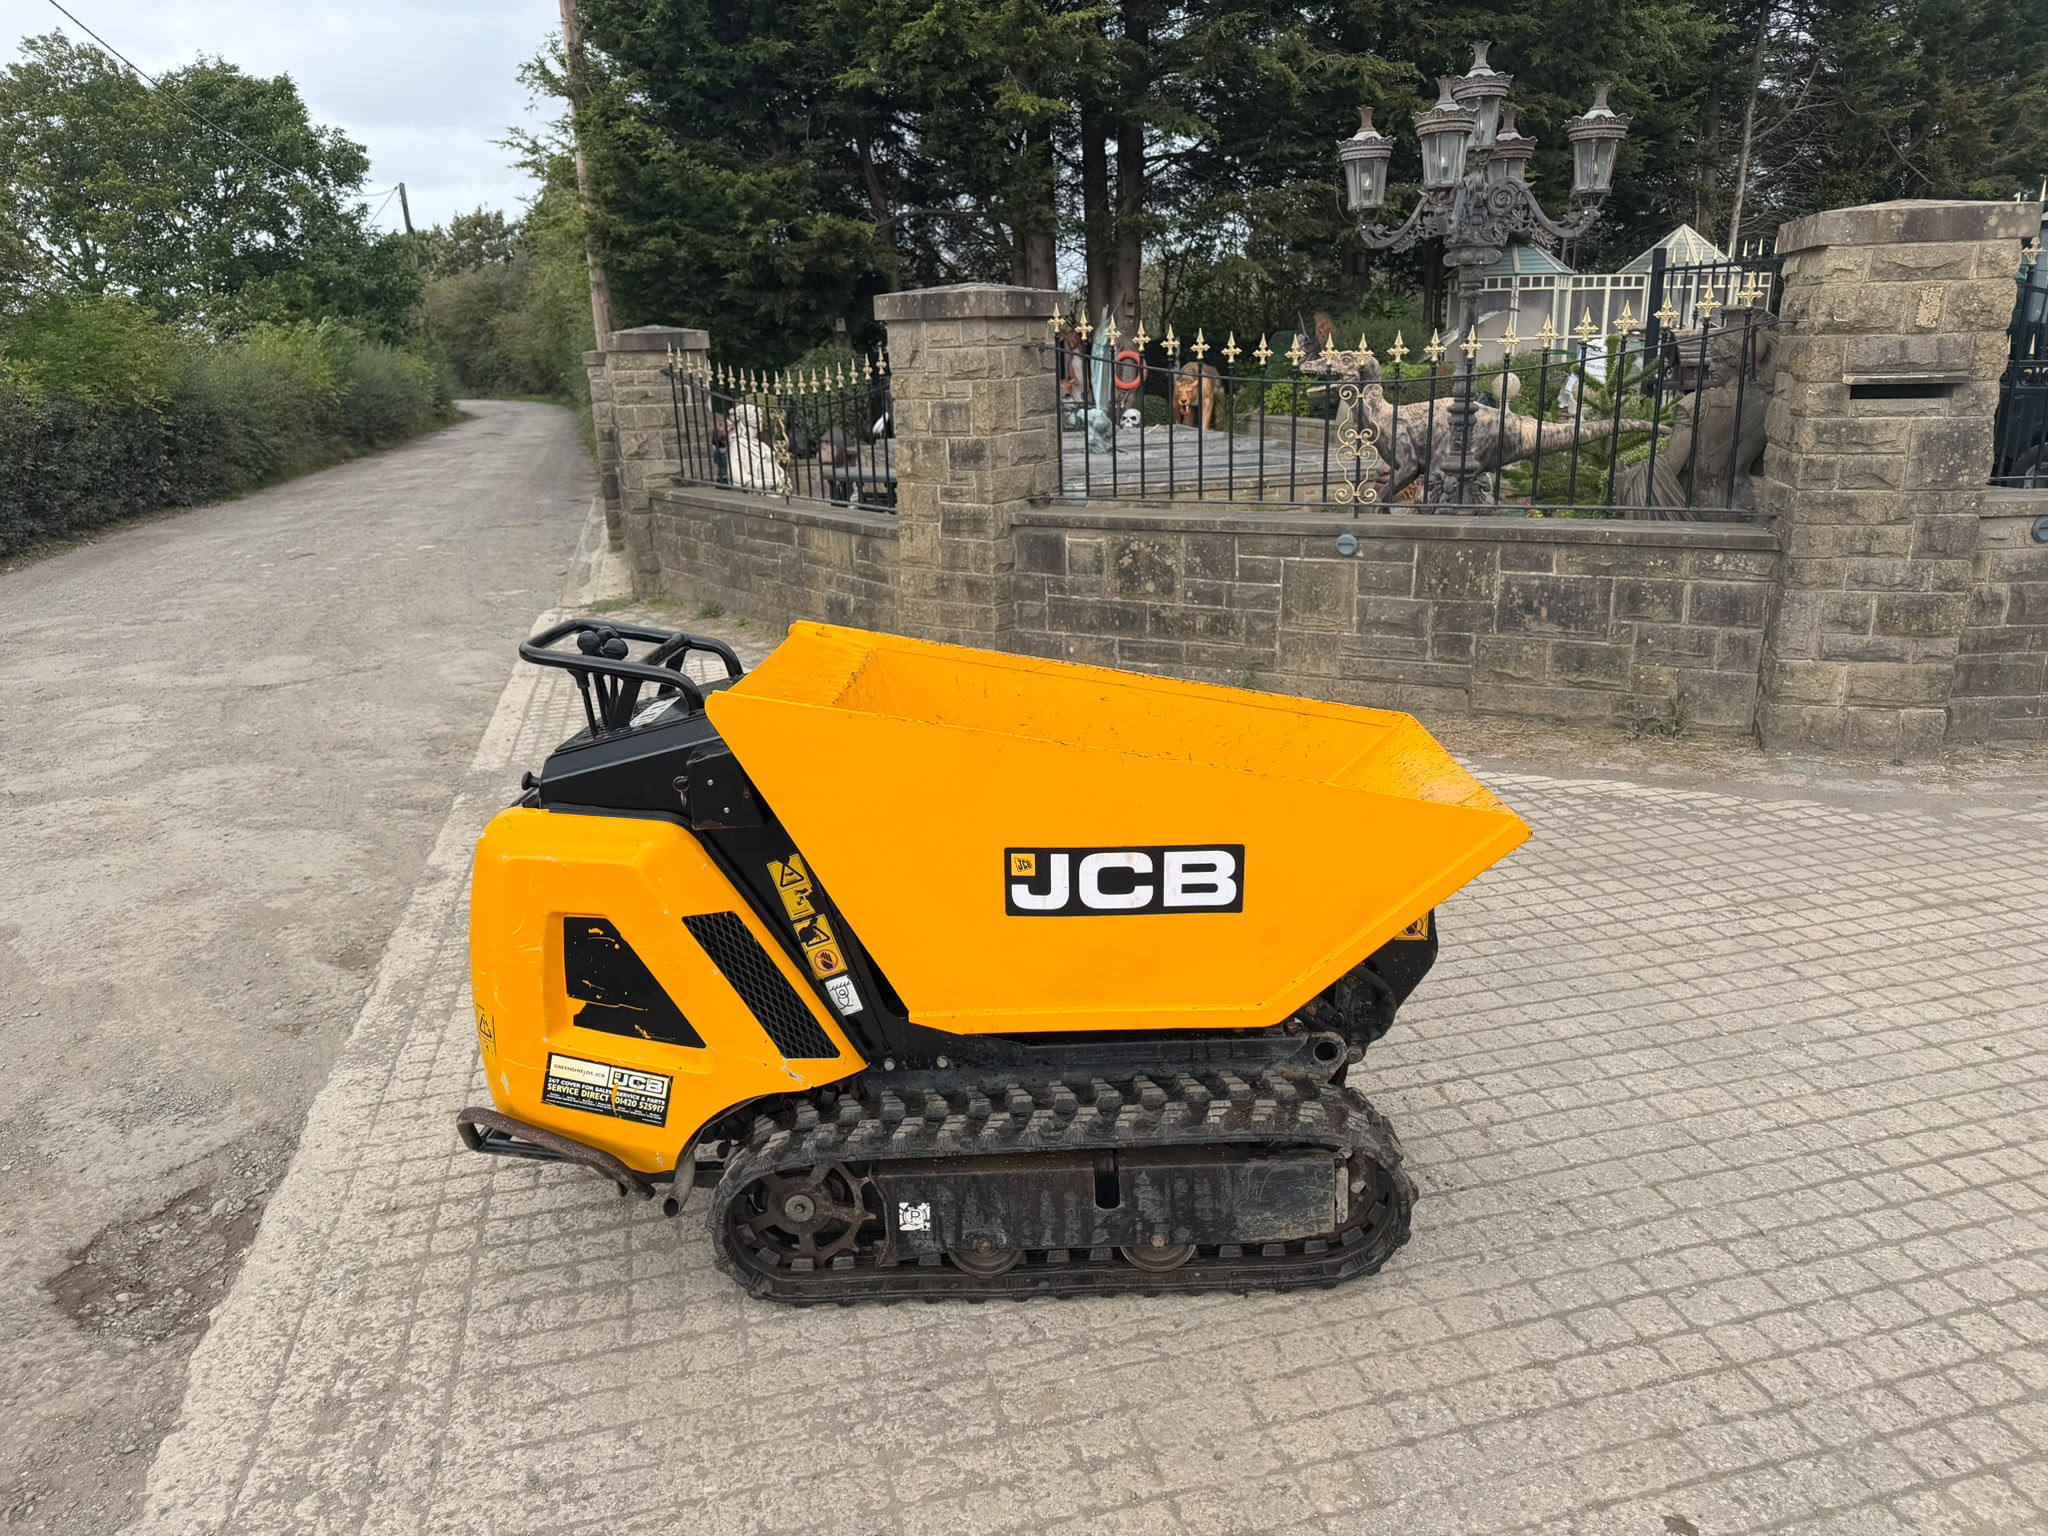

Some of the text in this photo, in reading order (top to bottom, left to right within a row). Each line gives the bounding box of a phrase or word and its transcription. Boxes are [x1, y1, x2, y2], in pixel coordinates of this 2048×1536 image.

[1011, 850, 1237, 910] JCB
[553, 1063, 593, 1076] GREENSHIELDS
[560, 1079, 581, 1088] COVER
[646, 1097, 666, 1106] PARTS
[613, 1073, 663, 1095] JCB
[547, 1083, 580, 1096] SERVICE
[581, 1089, 610, 1102] DIRECT
[615, 1096, 638, 1107] 01420
[638, 1101, 665, 1113] 525917
